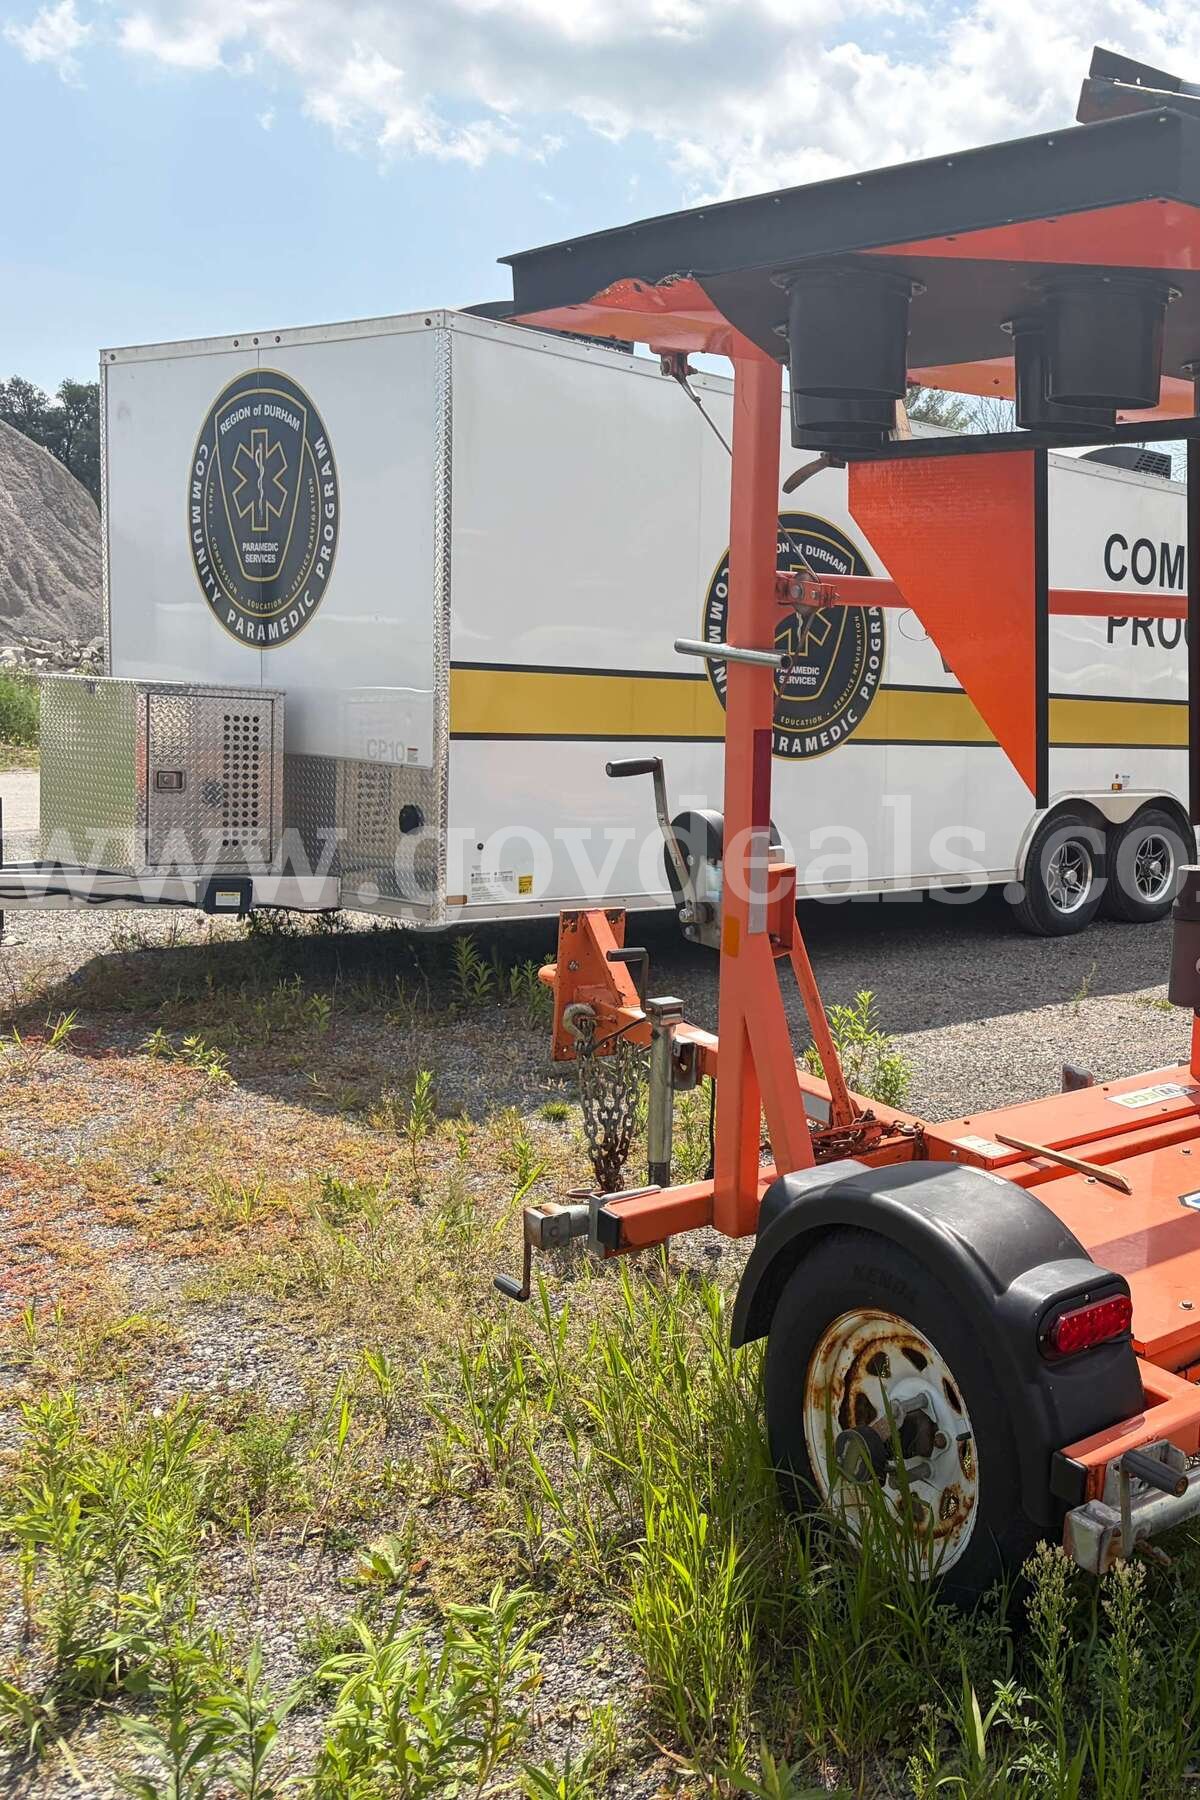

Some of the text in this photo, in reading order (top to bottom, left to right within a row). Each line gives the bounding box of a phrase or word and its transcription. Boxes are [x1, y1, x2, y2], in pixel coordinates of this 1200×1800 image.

[220, 404, 301, 435] REGION of DURHAM
[192, 436, 335, 641] COMMUNITY PARAMEDIC PROGRAM
[242, 542, 279, 553] PARAMEDIC
[245, 554, 277, 564] SERVICES
[247, 599, 283, 610] EDUCATION
[290, 555, 310, 592] SERVICE
[307, 478, 317, 549] NAVIGATION
[806, 544, 848, 575] DURHAM
[1104, 533, 1185, 590] COM
[780, 715, 823, 726] EDUCATION
[833, 678, 855, 710] SERVICE
[772, 708, 858, 753] RAMEDIC
